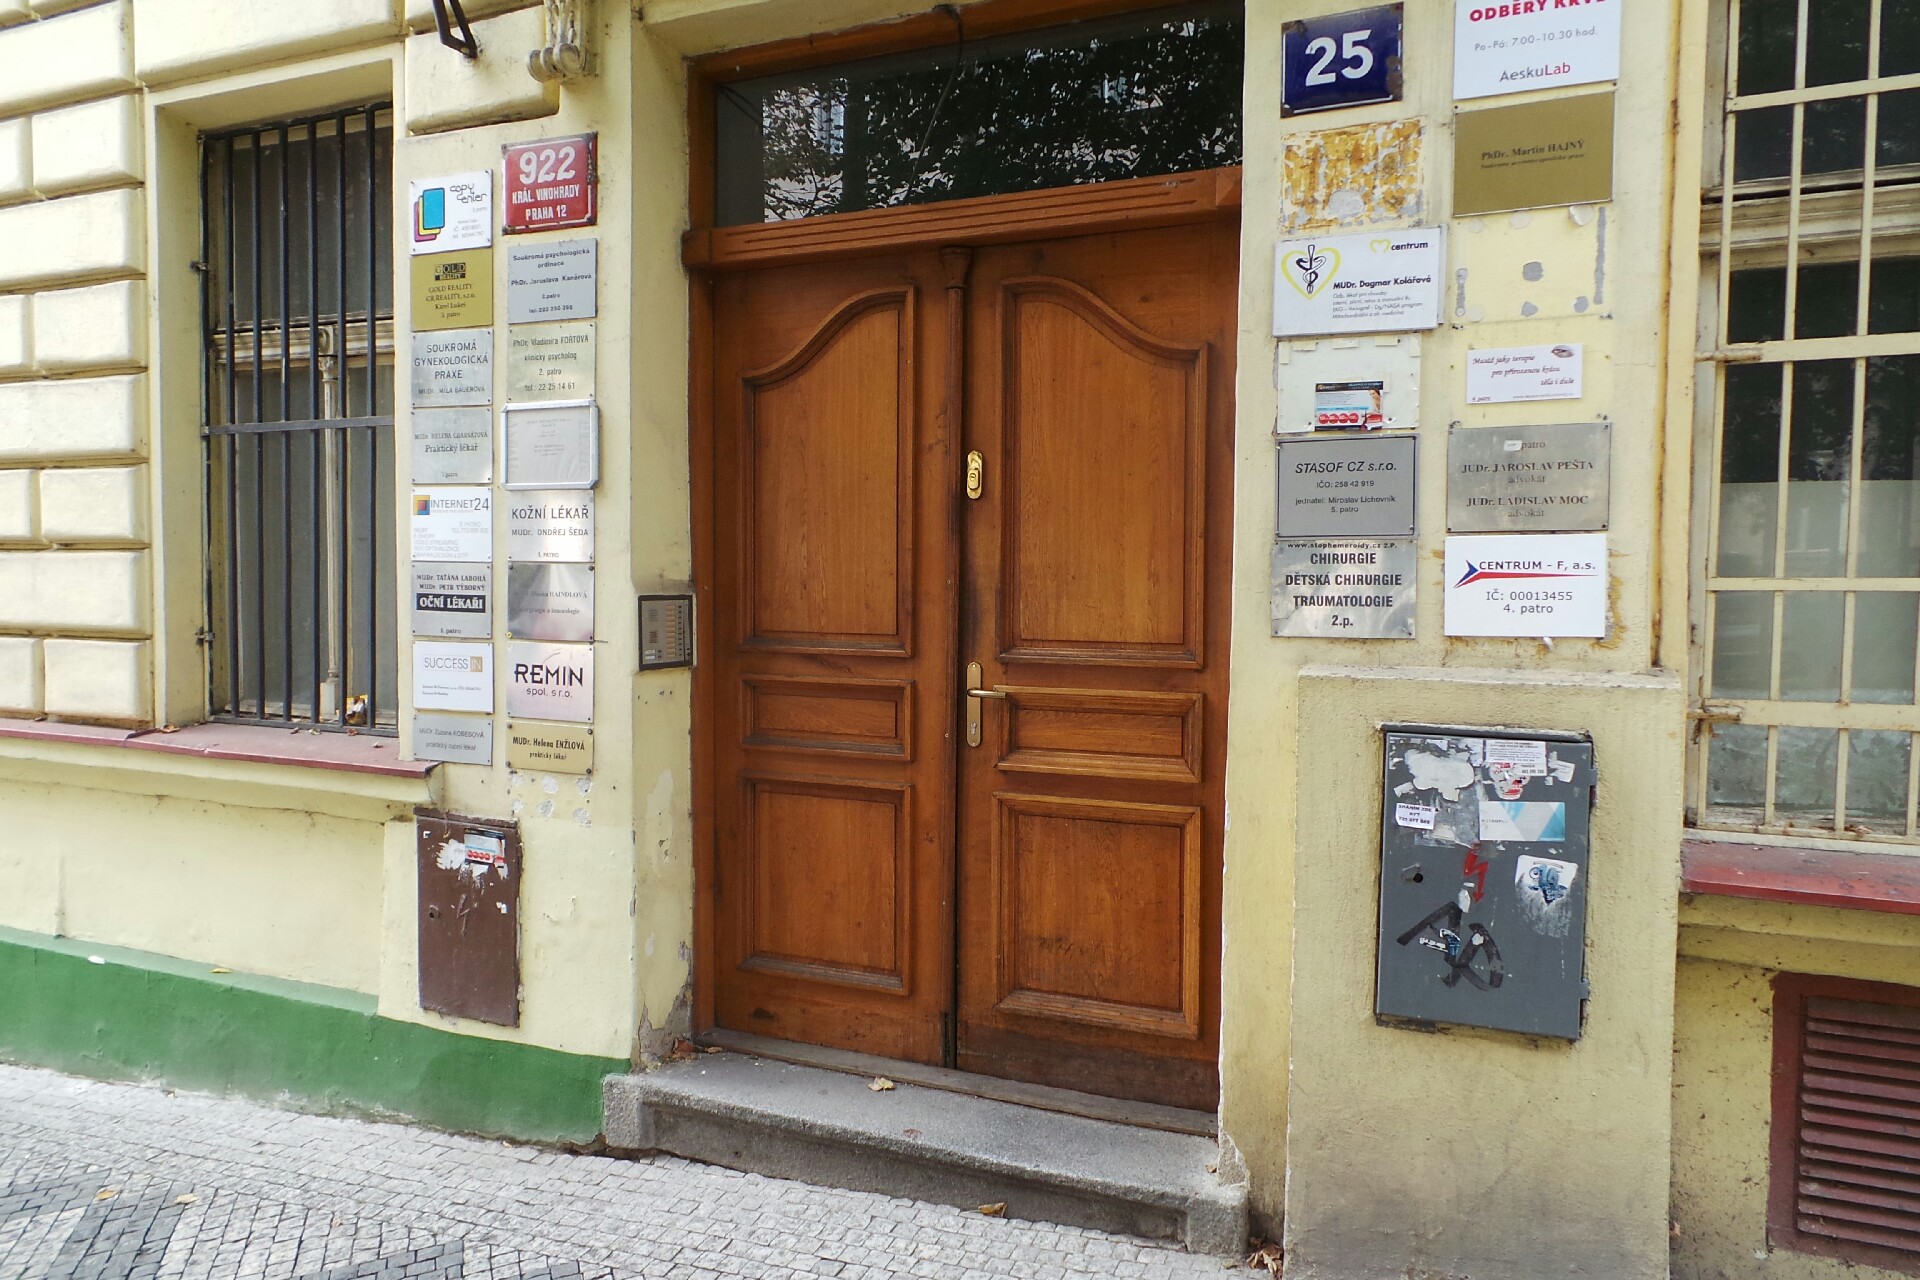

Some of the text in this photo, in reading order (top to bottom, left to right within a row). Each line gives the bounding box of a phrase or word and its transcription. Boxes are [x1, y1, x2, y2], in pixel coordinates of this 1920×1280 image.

[1469, 0, 1547, 22] ODBĚRY
[1575, 25, 1597, 37] hod.
[1304, 29, 1374, 87] 25
[1499, 62, 1571, 82] AeskuLab
[1512, 146, 1545, 156] Martin
[1547, 138, 1585, 152] HAJNÝ
[519, 145, 576, 185] 922
[512, 184, 580, 204] KRÁL. VINOHRADY
[525, 204, 567, 221] PRAHA 12
[1391, 241, 1429, 251] centrum
[513, 247, 590, 261] Soukromá psychologická
[435, 262, 466, 274] GOLD
[537, 261, 565, 269] ordinace
[530, 277, 559, 285] Jaroslava
[1333, 275, 1432, 289] MUDr. Dagmar Kolářová
[428, 283, 472, 293] GOLD REALITY
[426, 339, 477, 353] SOUKROMÁ
[414, 352, 489, 367] GYNEKOLOGICKÁ
[547, 352, 577, 361] psycholog
[1495, 355, 1511, 365] jako
[1512, 355, 1535, 363] terapie
[434, 369, 463, 380] PRAXE
[546, 368, 562, 376] patro
[1491, 370, 1503, 378] pro
[538, 383, 546, 391] 22
[558, 382, 565, 390] 14
[1540, 378, 1553, 386] těla
[1559, 377, 1574, 385] duše
[425, 442, 478, 454] Praktický lékař
[1521, 441, 1546, 450] patro
[1295, 461, 1397, 474] STASOF CZ s.r.o.
[1461, 460, 1594, 474] JUDr. JAROSLAV PEŠTA
[1316, 479, 1333, 489] IČO:
[1507, 475, 1546, 484] advokát
[430, 498, 489, 511] INTERNET24
[1328, 496, 1359, 504] Miroslav
[1466, 495, 1589, 507] JUDr. LADISLAV MOC
[511, 504, 589, 519] KOŽNÍ LÉKAŘ
[1507, 509, 1545, 518] advokát
[537, 527, 566, 536] ONDŘEJ
[568, 527, 589, 536] ŠEDA
[1310, 553, 1376, 565] CHIRURGIE
[1479, 561, 1542, 570] CENTRUM
[1557, 561, 1568, 571] F,
[1572, 562, 1596, 570] a.s.
[1285, 571, 1402, 586] DĚTSKÁ CHIRURGIE
[1486, 588, 1573, 601] IČ: 00013455
[420, 595, 483, 609] OČNÍ LÉKAŘI
[1293, 595, 1393, 608] TRAUMATOLOGIE
[1503, 604, 1553, 615] 4. patro
[1331, 614, 1353, 628] 2.p.
[424, 656, 469, 669] SUCCESS
[514, 663, 583, 688] REMIN
[526, 688, 548, 697] spol.
[512, 736, 532, 746] MUDr.
[533, 737, 554, 748] Helena
[529, 751, 552, 761] praktický
